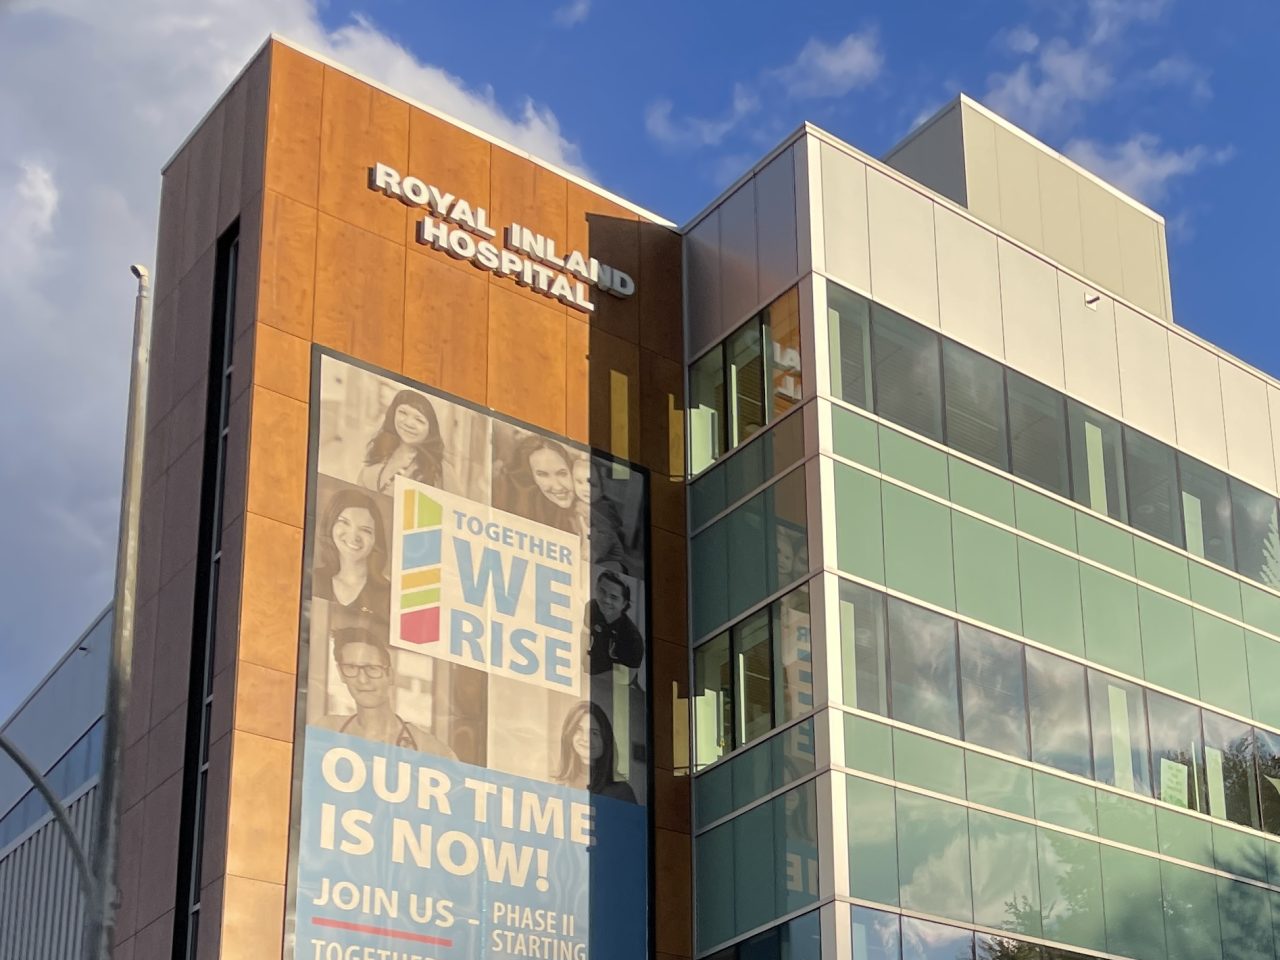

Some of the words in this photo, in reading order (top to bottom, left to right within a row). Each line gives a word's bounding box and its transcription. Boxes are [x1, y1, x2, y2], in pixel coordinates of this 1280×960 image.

[369, 162, 496, 239] ROYAL
[504, 223, 635, 298] INLAND
[416, 216, 595, 312] HOSPITAL
[452, 510, 573, 565] TOGETHER
[452, 536, 573, 634] WE
[450, 608, 573, 687] RISE
[321, 747, 452, 815] OUR
[464, 777, 597, 846] TIME
[320, 803, 375, 856] IS
[391, 818, 549, 892] NOW!
[312, 878, 398, 918] JOIN
[409, 893, 455, 928] US
[493, 902, 556, 934] PHASE
[562, 913, 575, 937] II
